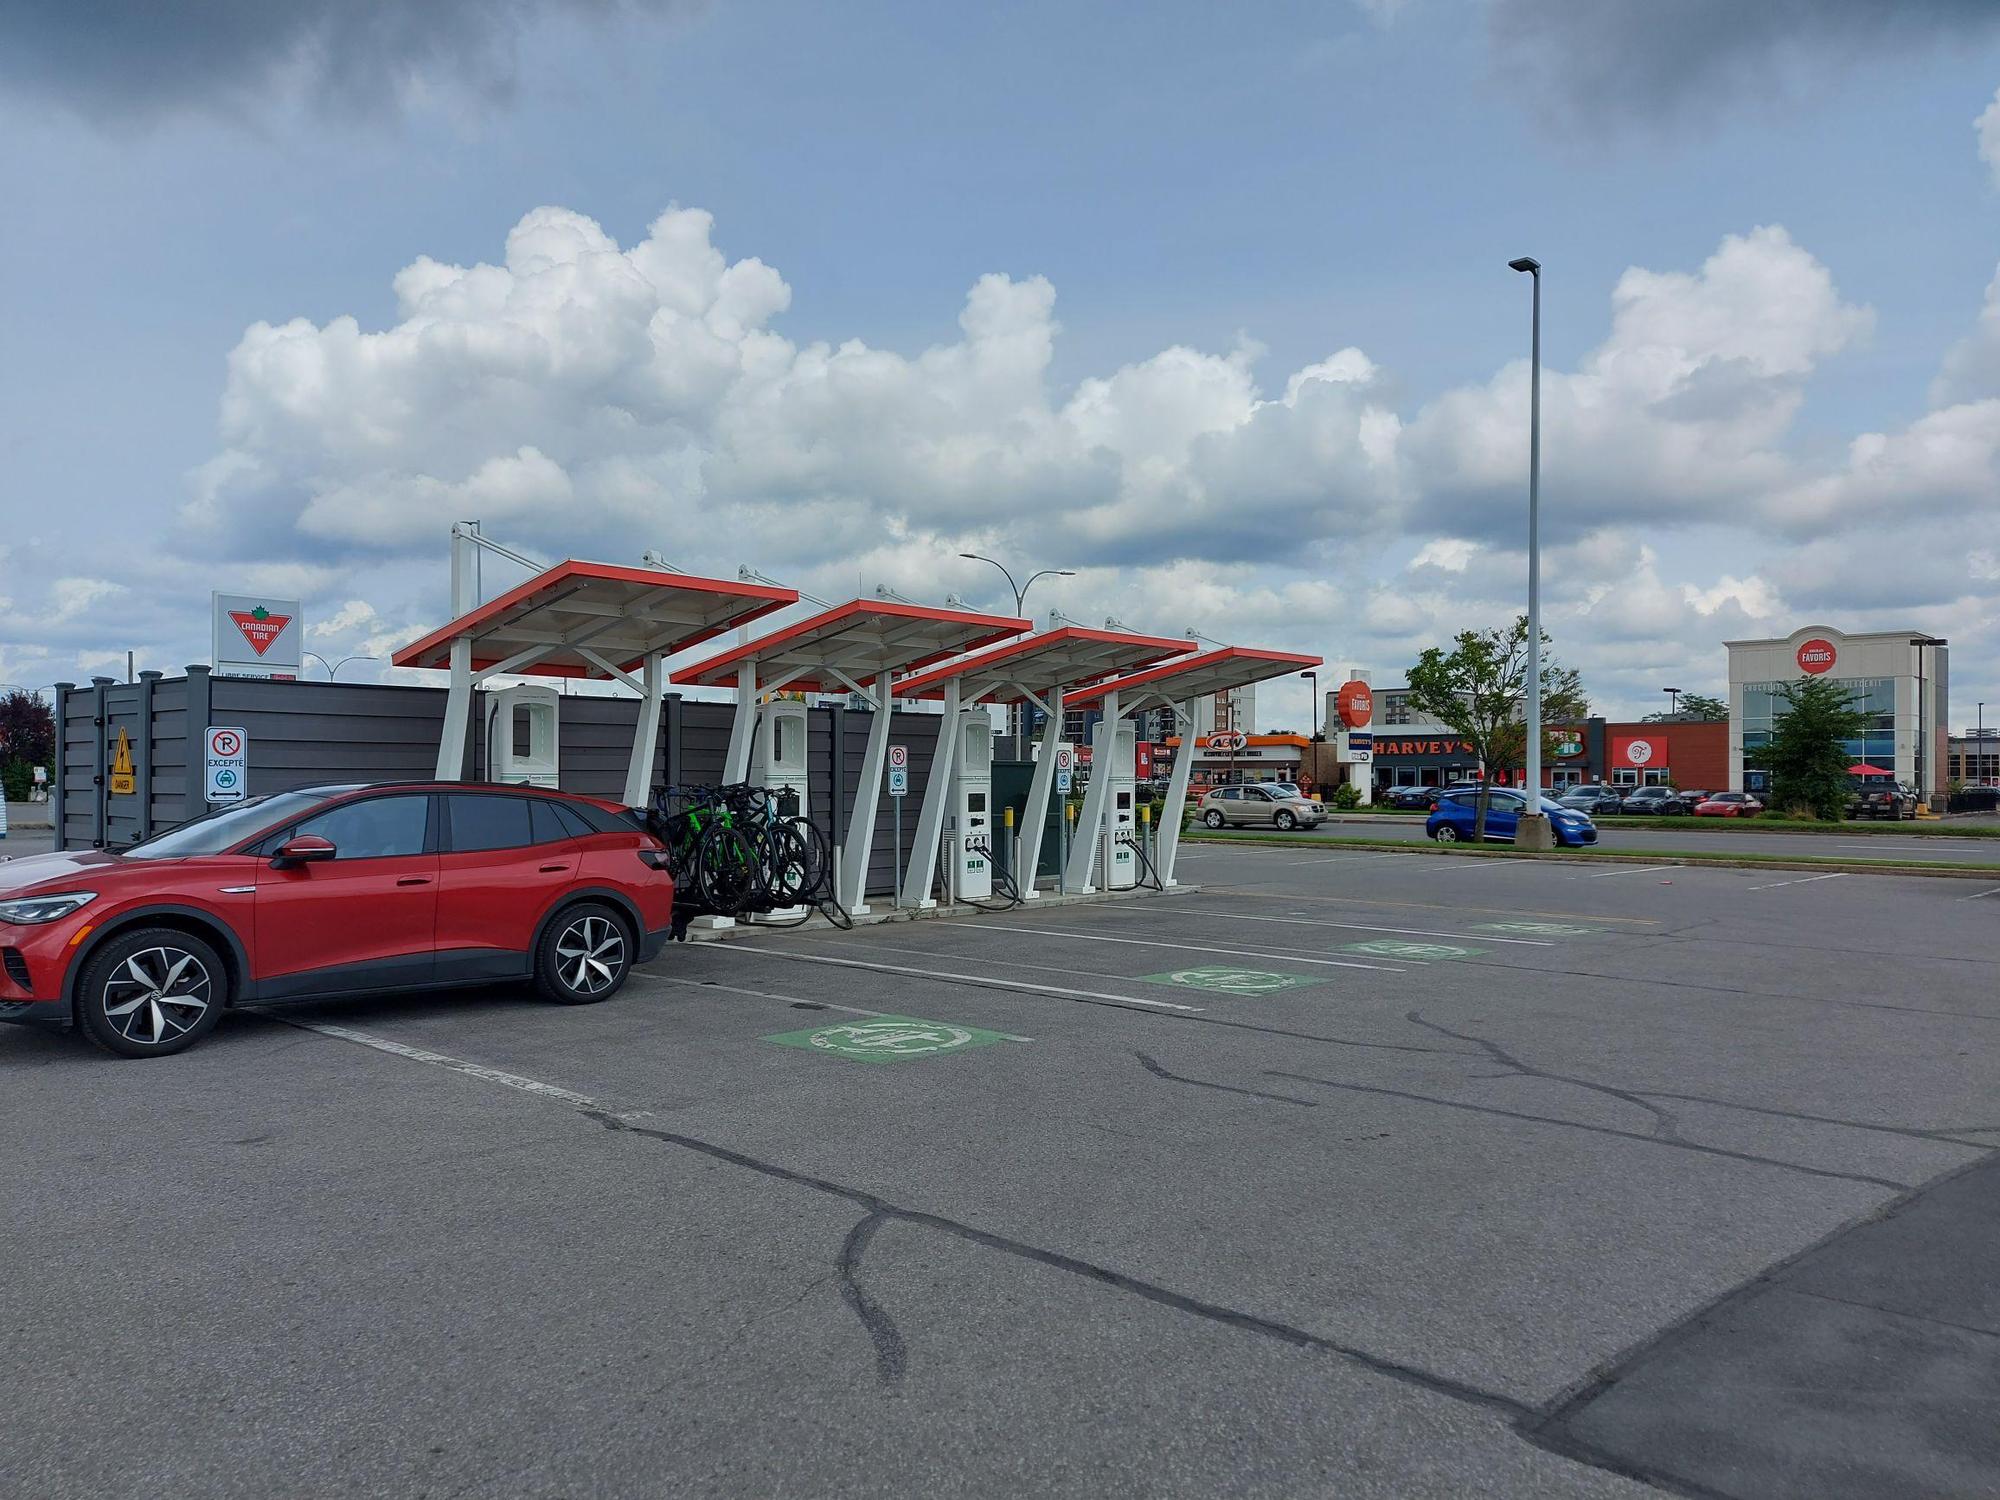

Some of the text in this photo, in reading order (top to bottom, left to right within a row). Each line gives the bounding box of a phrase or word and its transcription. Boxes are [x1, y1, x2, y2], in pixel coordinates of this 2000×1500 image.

[241, 622, 279, 632] CANADIAN
[252, 631, 269, 640] TIRE
[1802, 652, 1831, 662] FAVORIS
[1373, 741, 1473, 754] HARVEY'S
[208, 758, 244, 767] EXCEPTÉ
